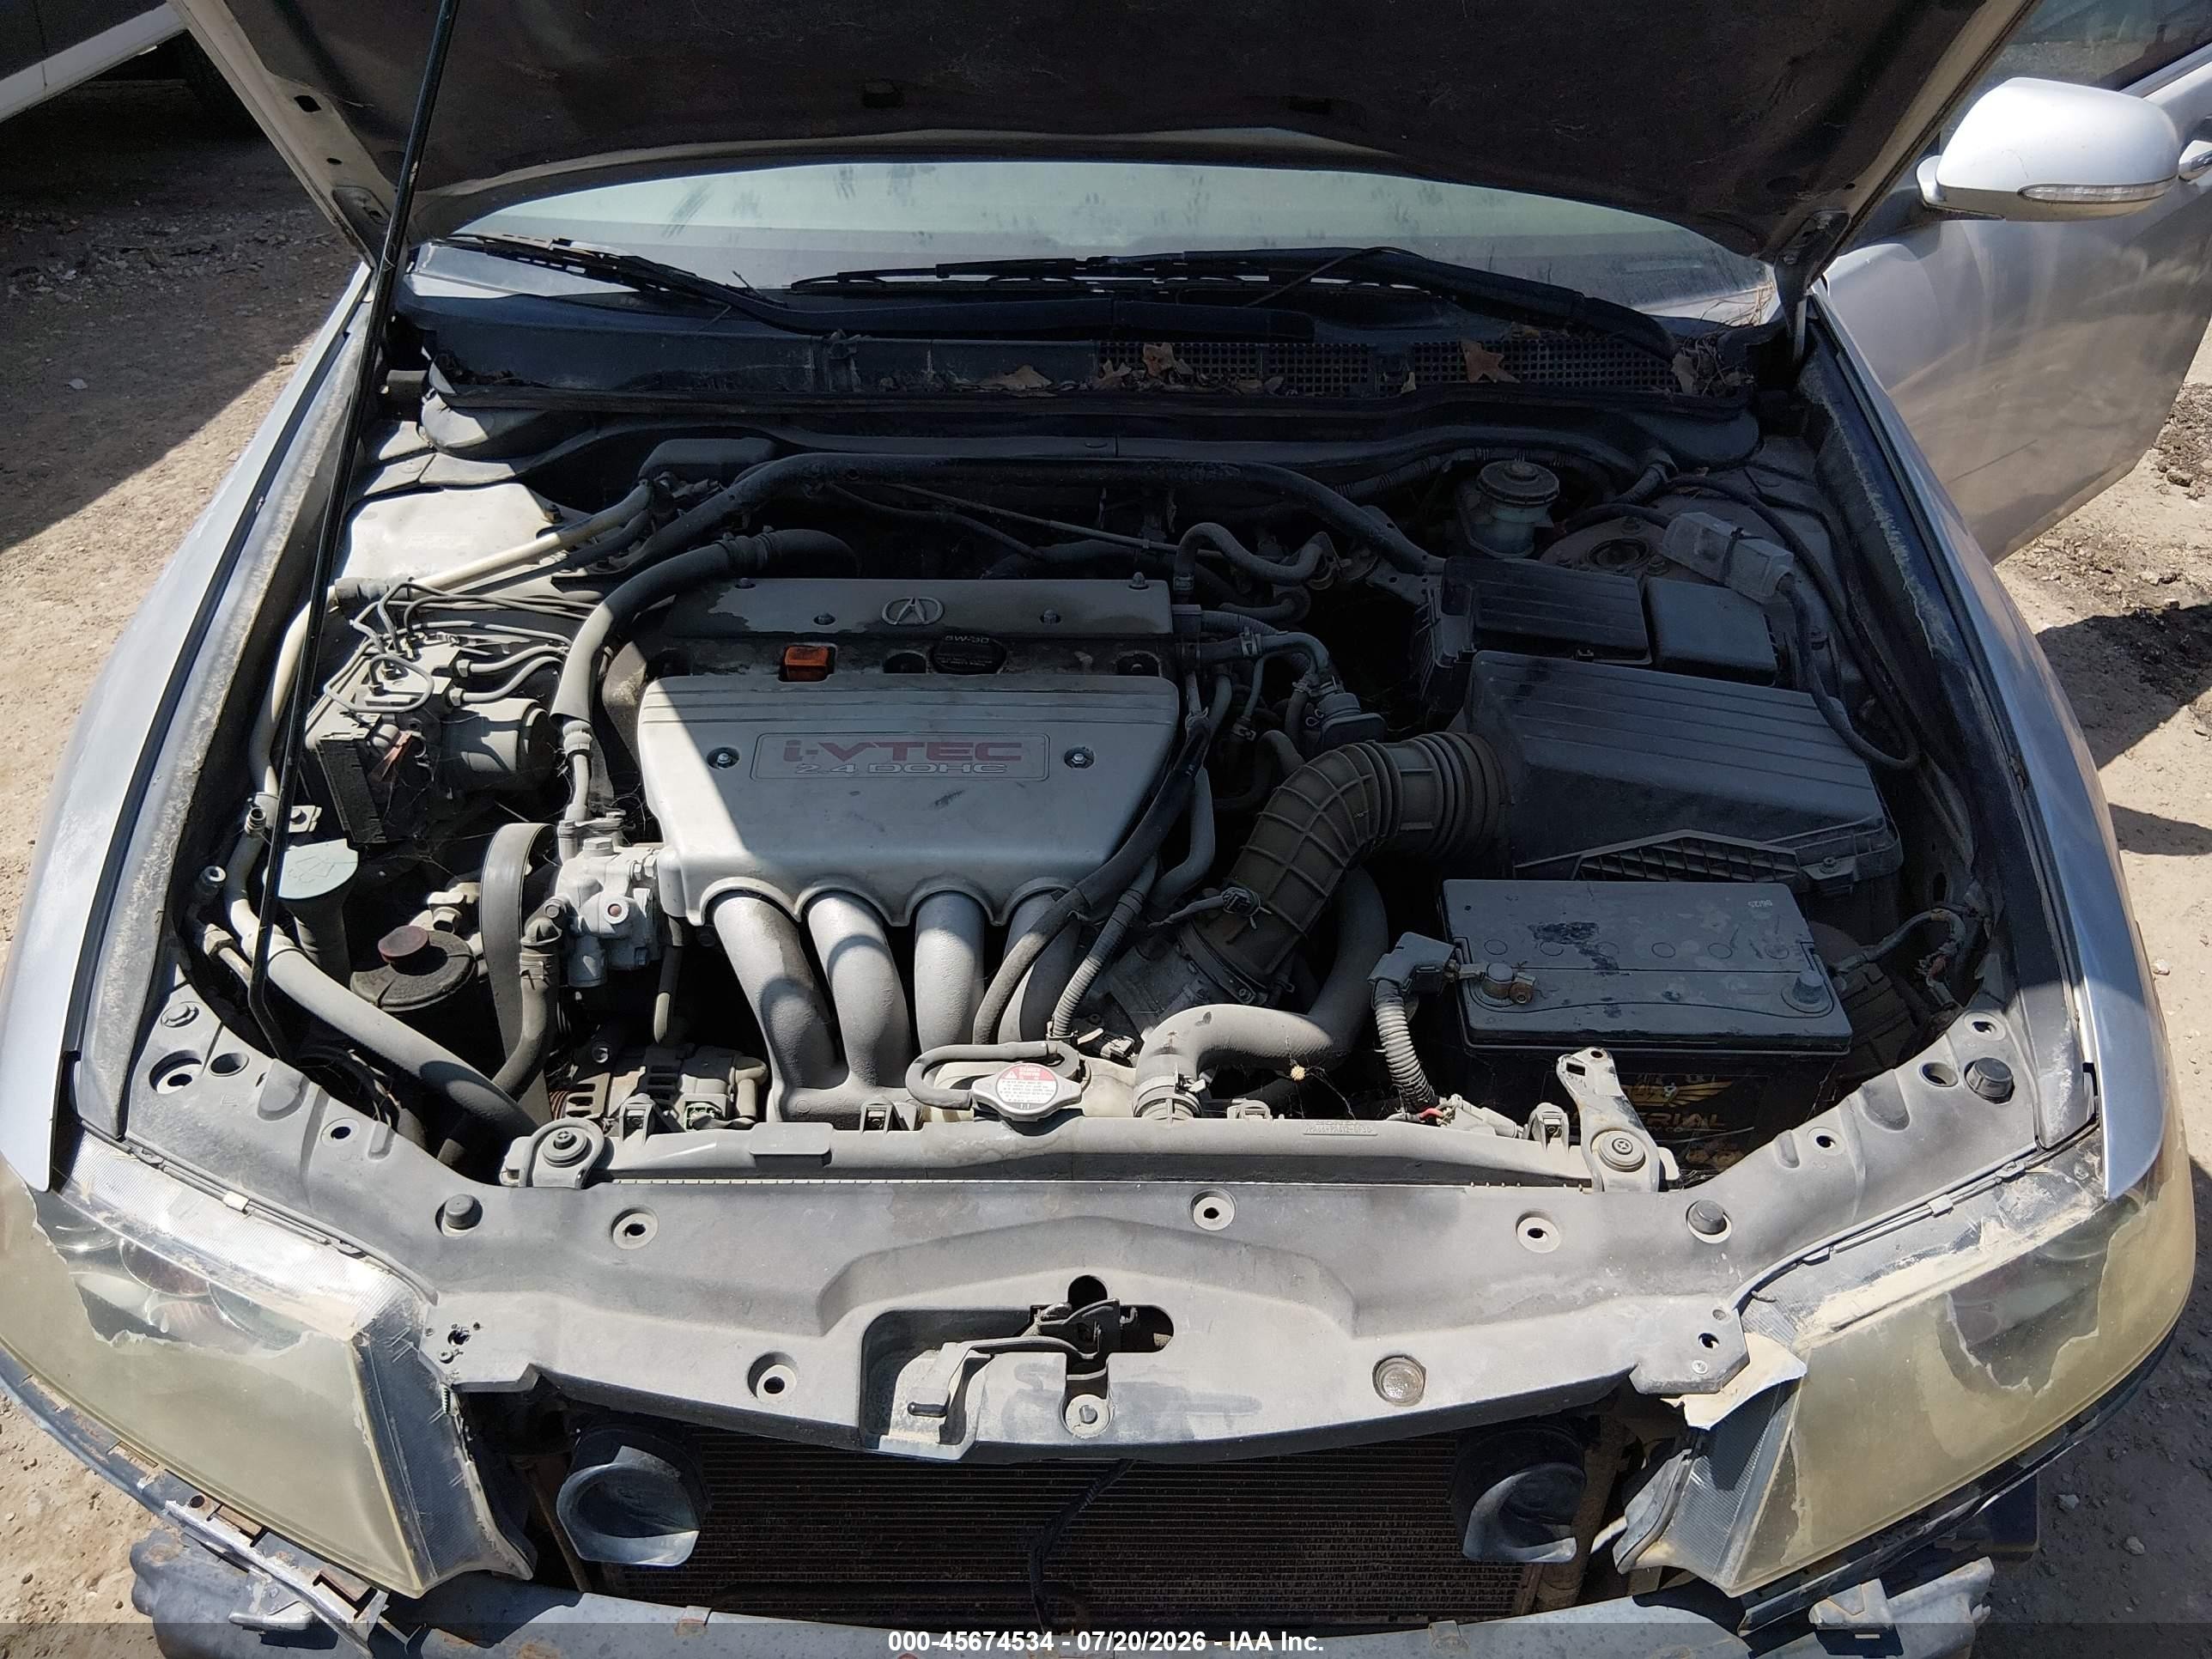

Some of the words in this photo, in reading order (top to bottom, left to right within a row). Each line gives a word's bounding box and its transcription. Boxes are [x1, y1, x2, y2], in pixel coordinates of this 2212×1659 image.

[783, 740, 1022, 762] i-VTEC
[796, 763, 859, 774] 2.4
[868, 763, 1008, 774] DOHC
